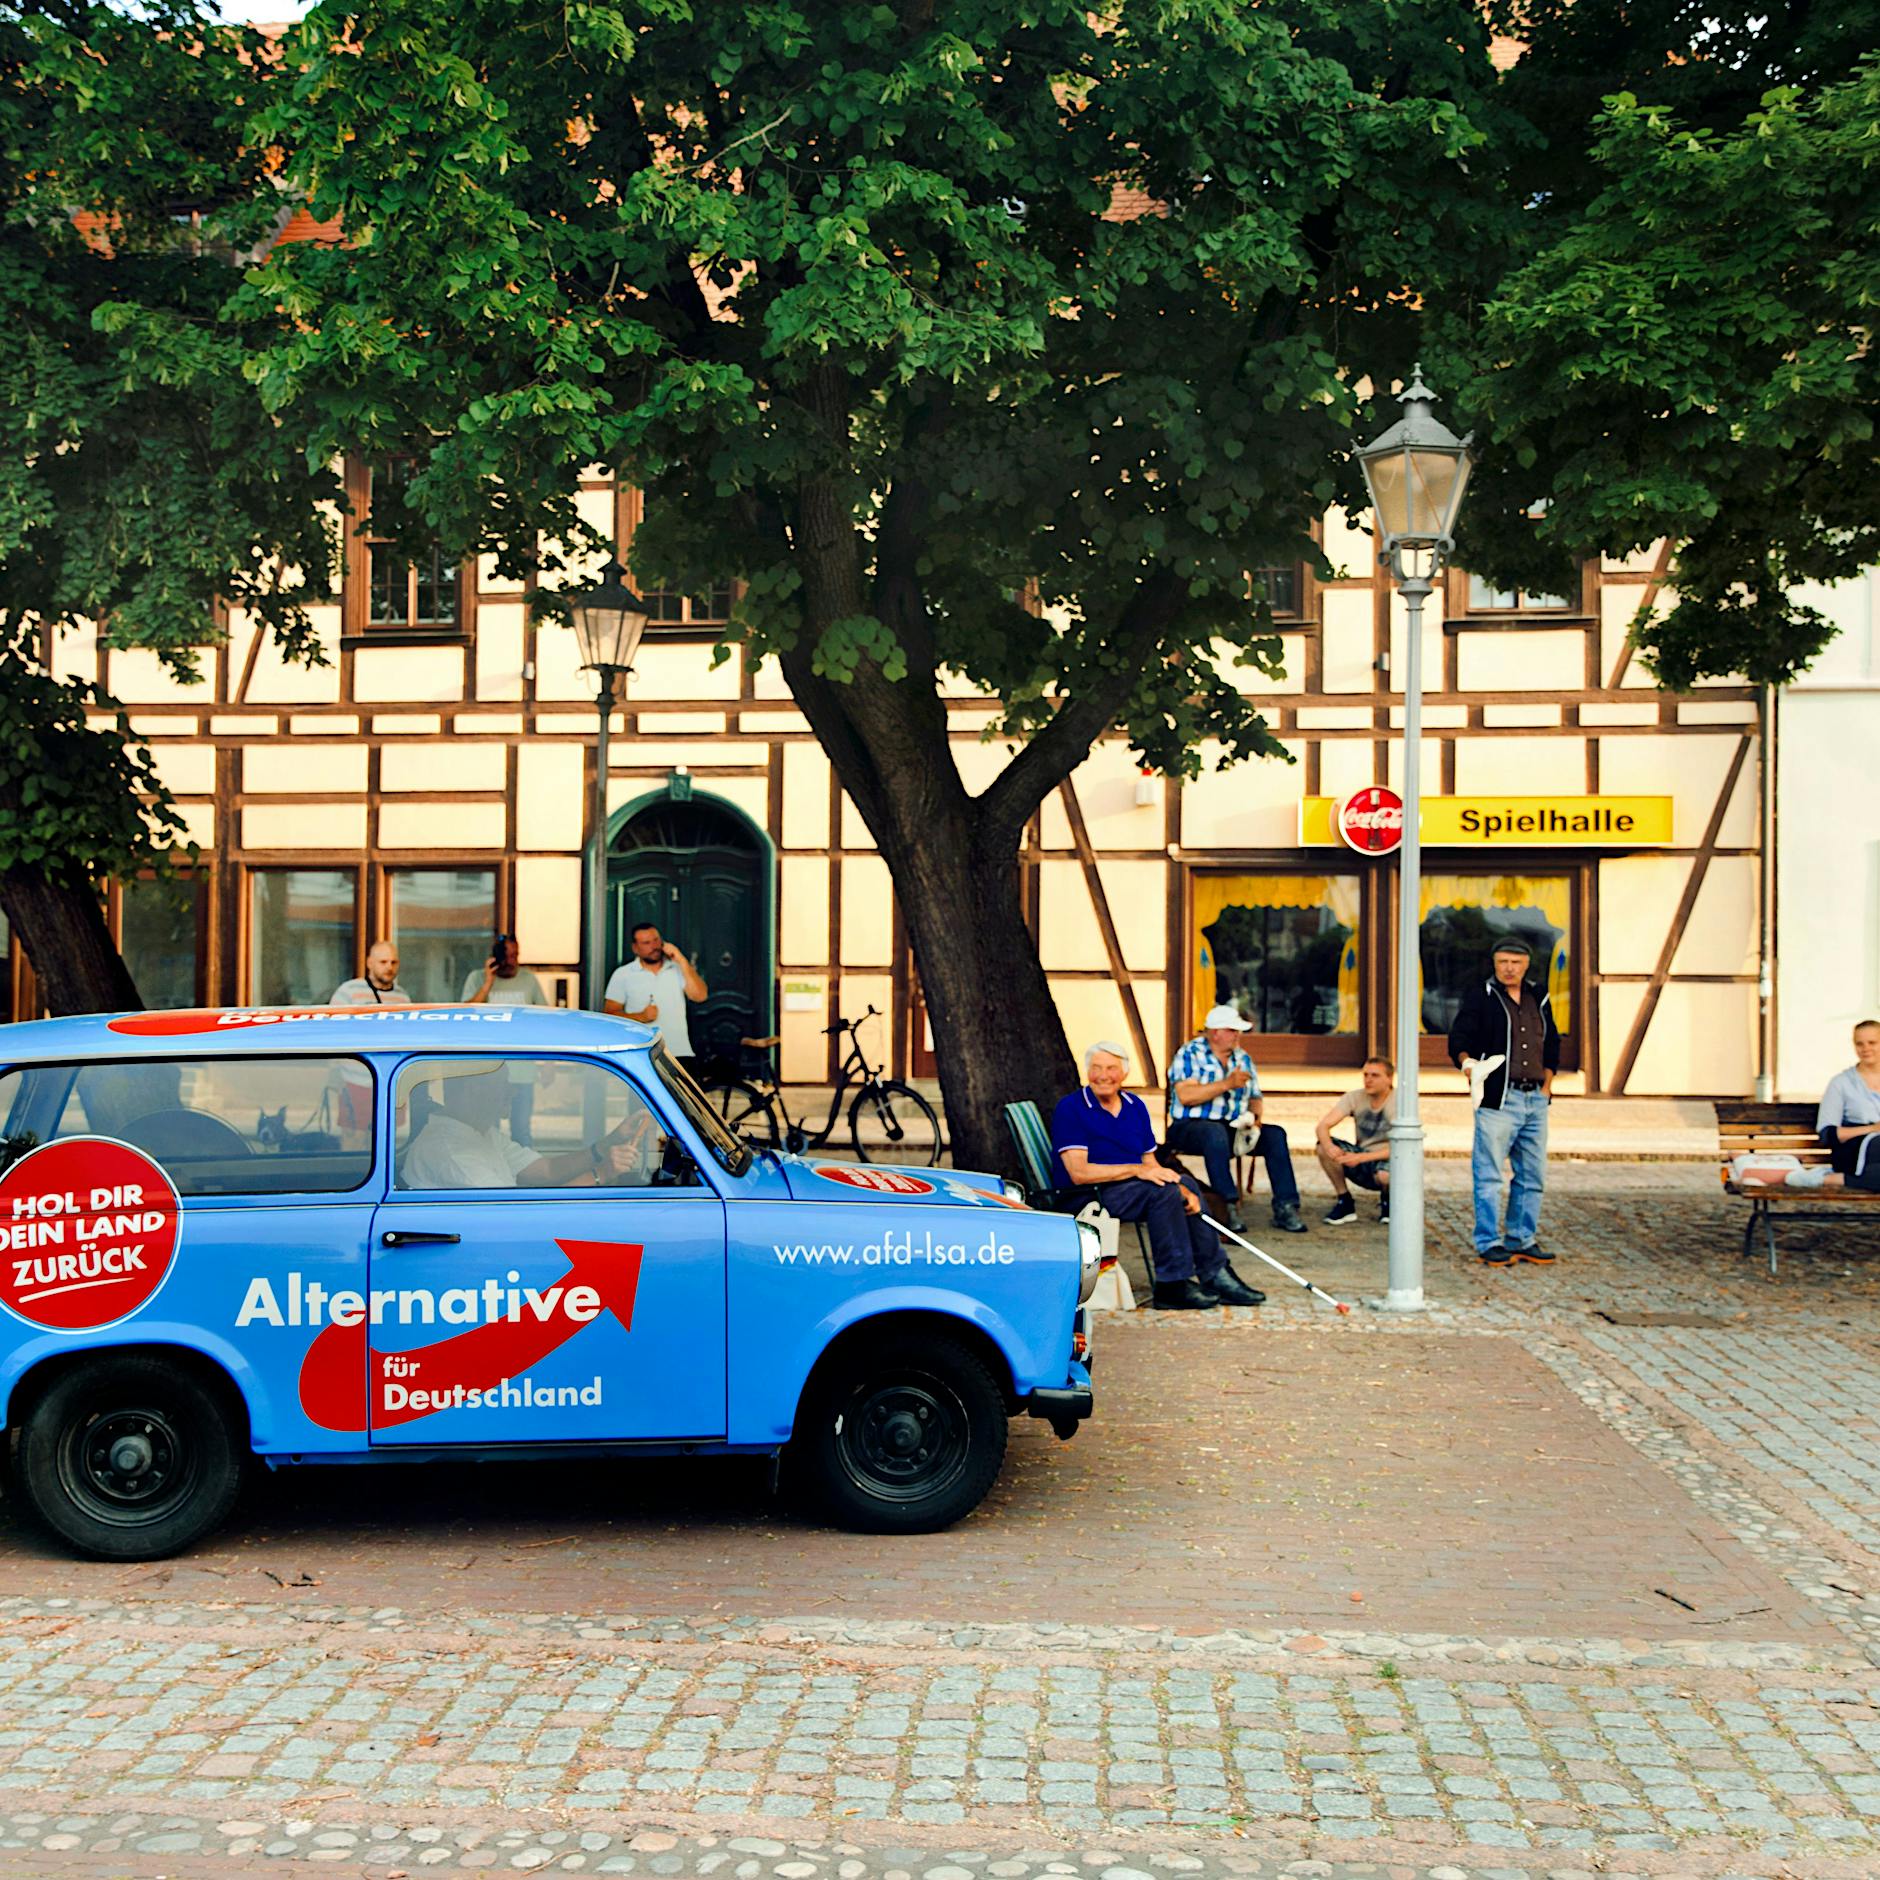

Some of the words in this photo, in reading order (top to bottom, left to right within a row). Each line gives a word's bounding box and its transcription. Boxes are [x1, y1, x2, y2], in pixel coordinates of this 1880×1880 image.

[1460, 809, 1634, 838] Spielhalle
[217, 1010, 513, 1025] Deutschland
[12, 1192, 80, 1220] HOL
[90, 1184, 144, 1210] DIR
[76, 1211, 166, 1241] LAND
[12, 1243, 147, 1287] ZURÜCK
[773, 1231, 1015, 1265] www.afd-lsa.de
[235, 1271, 601, 1327] Alternative
[382, 1356, 421, 1378] für
[383, 1377, 602, 1411] Deutschland
